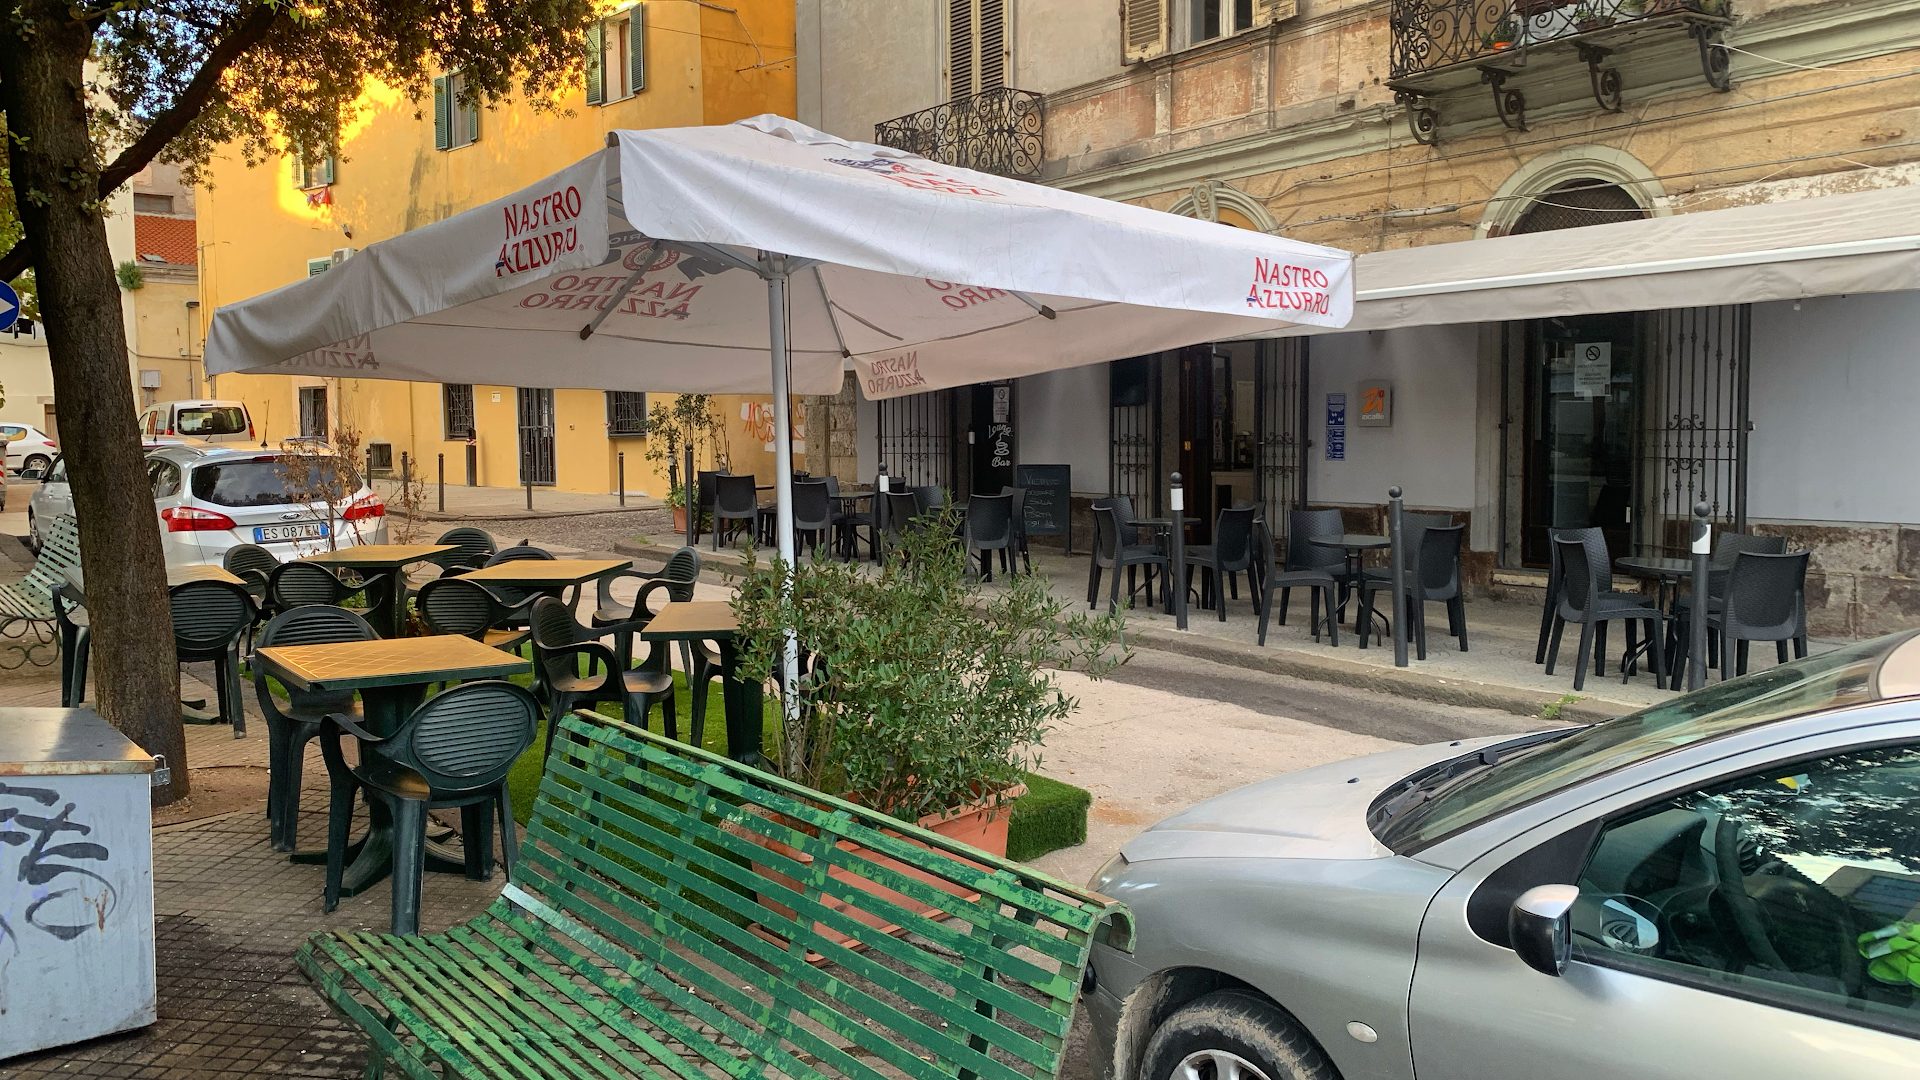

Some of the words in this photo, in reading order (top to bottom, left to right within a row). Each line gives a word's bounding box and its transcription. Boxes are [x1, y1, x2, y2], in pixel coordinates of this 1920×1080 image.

[503, 186, 581, 240] NASTRO
[1254, 256, 1329, 289] NASTRO
[1246, 284, 1330, 315] AZZURRO
[991, 456, 1012, 467] Bar
[263, 528, 278, 540] ES
